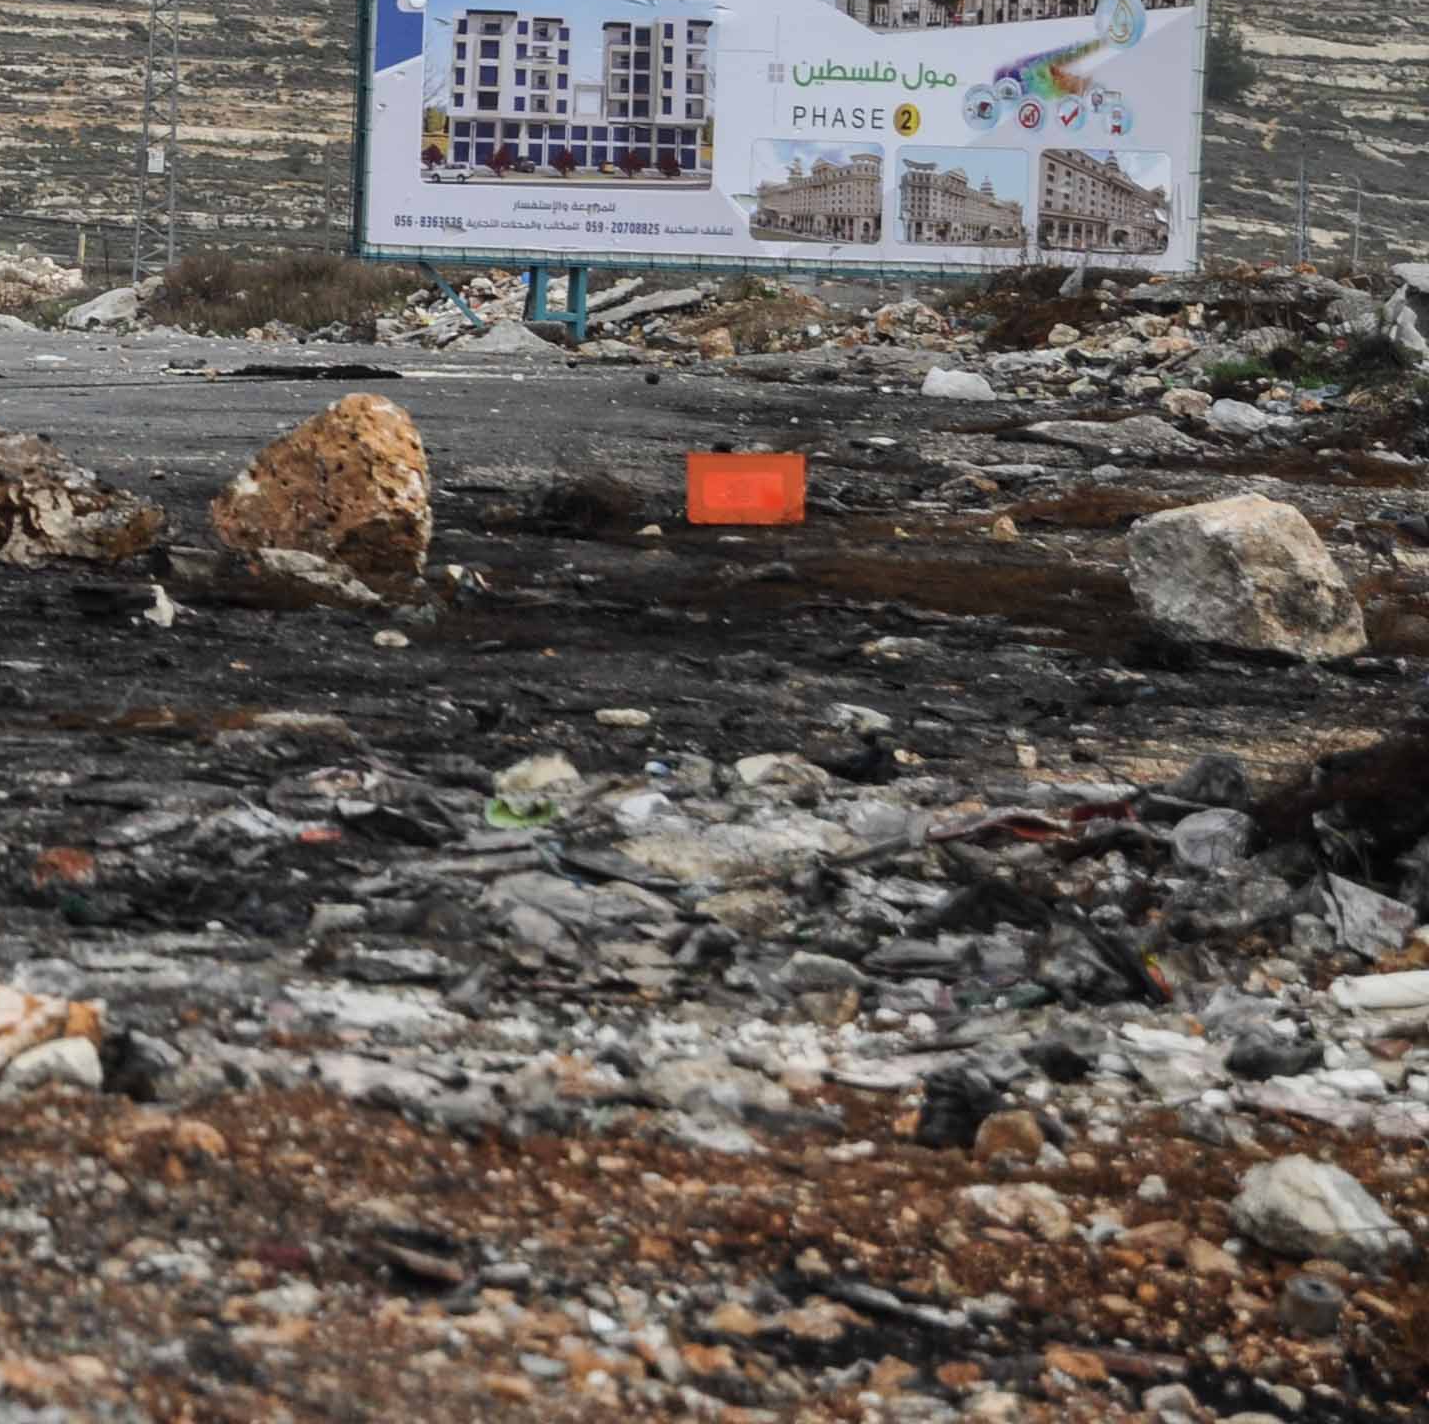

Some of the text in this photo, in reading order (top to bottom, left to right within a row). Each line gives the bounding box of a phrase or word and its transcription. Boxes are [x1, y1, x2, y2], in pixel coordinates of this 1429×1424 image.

[793, 59, 957, 90] مول فلسطين
[793, 106, 884, 129] PHASE
